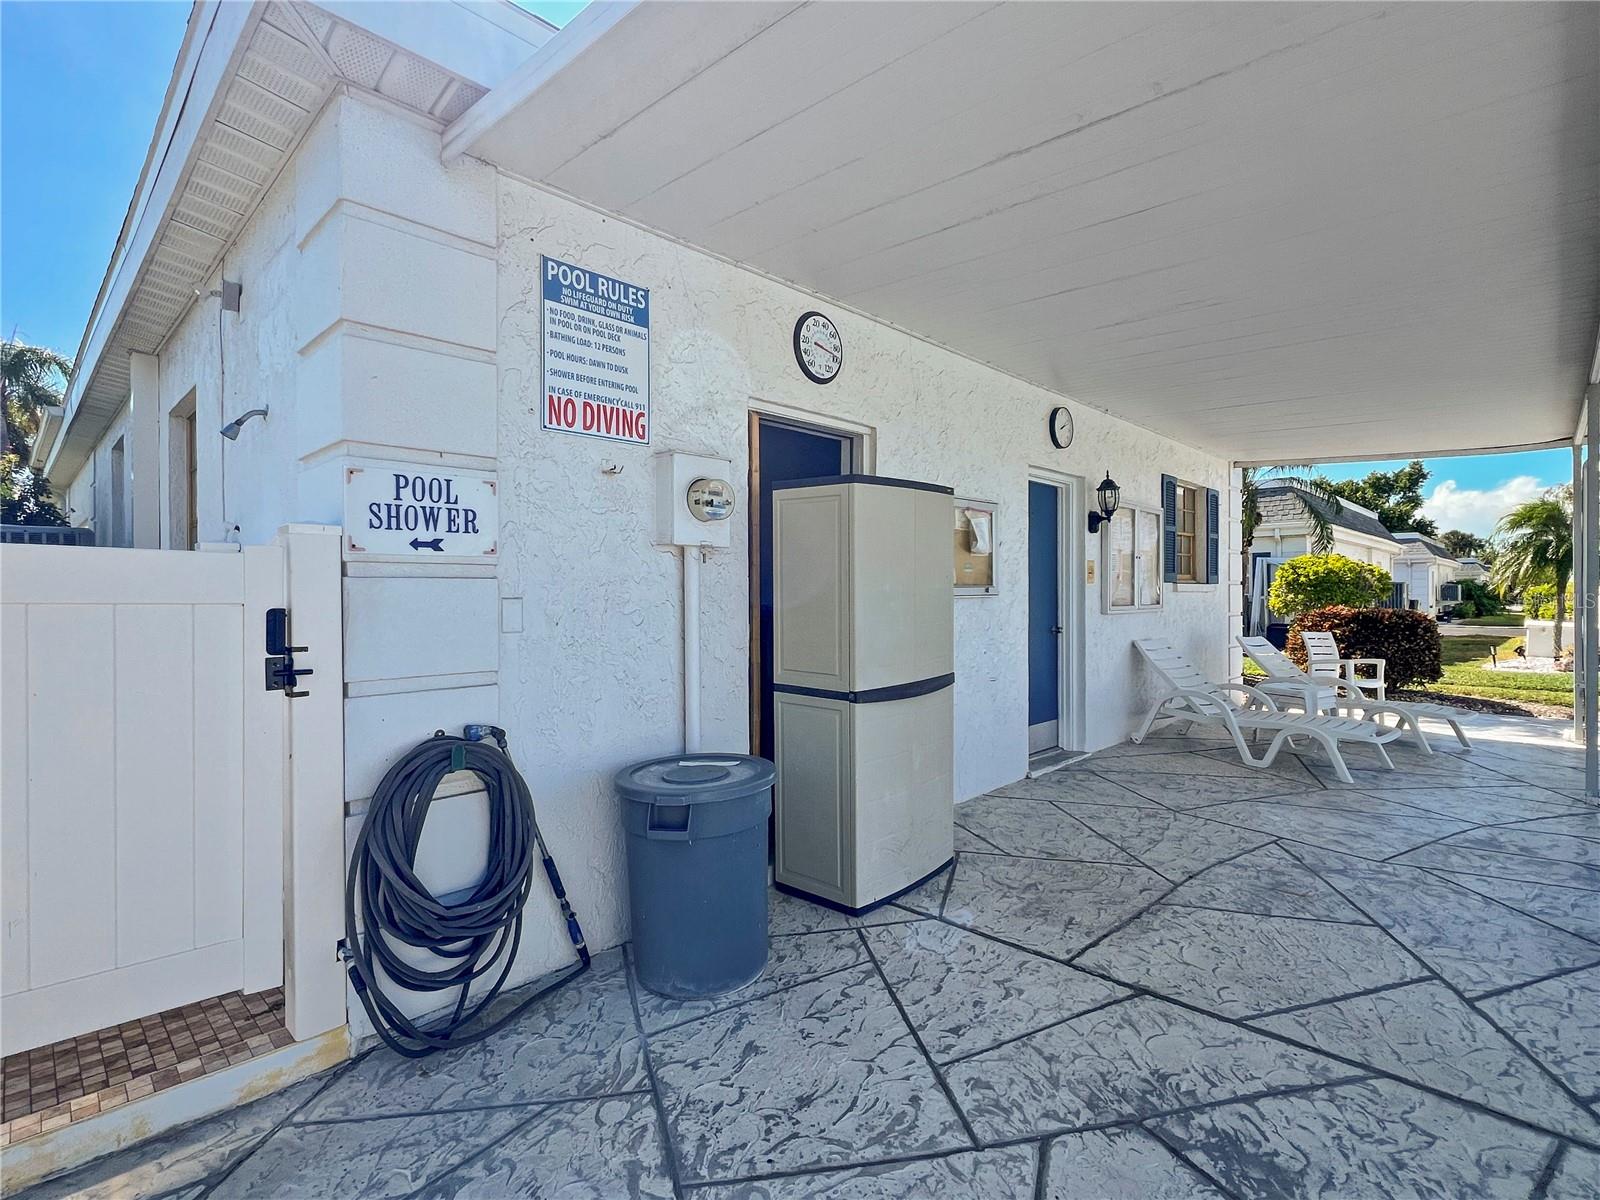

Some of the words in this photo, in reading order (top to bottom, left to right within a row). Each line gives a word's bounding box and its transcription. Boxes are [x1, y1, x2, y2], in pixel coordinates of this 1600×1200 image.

[548, 261, 594, 293] POOL
[598, 278, 645, 308] RULES
[561, 295, 579, 307] SWIM
[588, 303, 605, 315] YOUR
[606, 309, 620, 319] OWN
[622, 313, 634, 323] RISK
[563, 287, 572, 296] NO
[572, 290, 606, 306] LIFEGUARD
[608, 302, 616, 310] ON
[618, 304, 633, 314] DUTY
[549, 307, 558, 316] NO
[560, 309, 576, 322] FOOD,
[578, 315, 597, 328] DRINK,
[599, 321, 615, 331] GLASS
[624, 328, 647, 340] ANIMALS
[558, 320, 572, 329] POOL
[574, 324, 582, 332] OR
[583, 326, 591, 334] ON
[592, 328, 607, 339] POOL
[608, 333, 621, 342] DECK
[813, 318, 820, 327] 20
[821, 322, 829, 330] 40
[829, 331, 836, 340] 60
[550, 331, 575, 344] BATHING
[577, 338, 593, 348] LOAD:
[594, 342, 601, 350] 12
[602, 344, 626, 356] PERSONS
[550, 349, 565, 360] POOL
[567, 353, 588, 365] HOURS:
[589, 359, 605, 368] DAWN
[615, 364, 628, 374] DUSK
[550, 368, 575, 380] SHOWER
[576, 374, 597, 385] BEFORE
[598, 379, 624, 391] ENTERING
[625, 384, 638, 394] POOL
[558, 388, 572, 397] CASE
[584, 393, 620, 405] EMERGENCY
[621, 400, 634, 409] CALL
[548, 395, 576, 428] NO
[583, 401, 645, 440] DIVING
[393, 474, 458, 504] POOL
[369, 502, 479, 534] SHOWER
